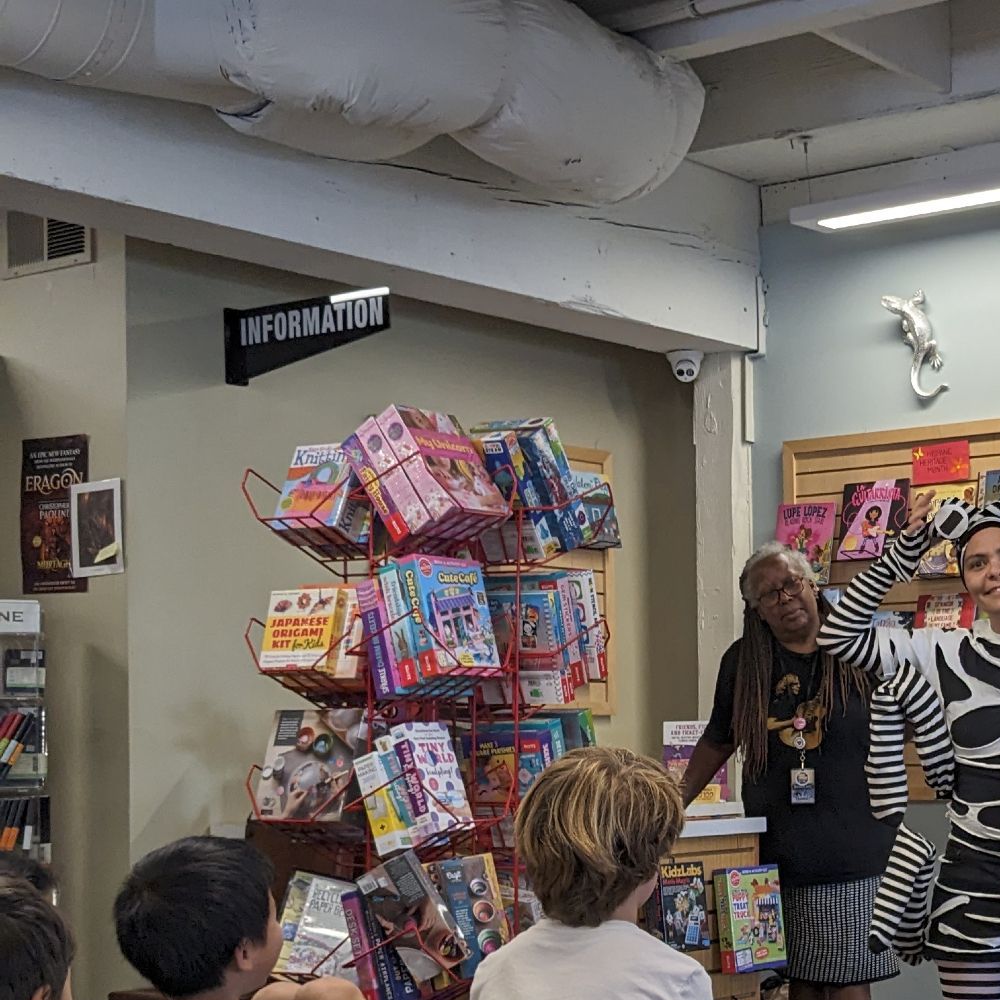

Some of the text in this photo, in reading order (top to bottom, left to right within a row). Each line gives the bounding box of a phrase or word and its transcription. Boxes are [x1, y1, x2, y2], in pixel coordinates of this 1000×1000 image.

[240, 297, 383, 346] INFORMATION
[294, 449, 345, 467] Knittin
[25, 468, 84, 495] ERAGON
[783, 507, 801, 519] LUPE
[405, 570, 417, 597] Cute
[438, 571, 478, 586] Cute Café
[270, 616, 329, 628] JAPANESE
[272, 627, 324, 638] ORIGAMI
[272, 639, 291, 648] KIT
[303, 638, 324, 650] Kids
[418, 742, 445, 753] TINY
[412, 772, 426, 813] WORLD
[661, 864, 702, 879] KidzLabs
[313, 889, 341, 901] RECYCL
[733, 903, 748, 911] TREAT
[345, 909, 363, 956] DESK SET
[381, 961, 394, 1000] AIRPLANES
